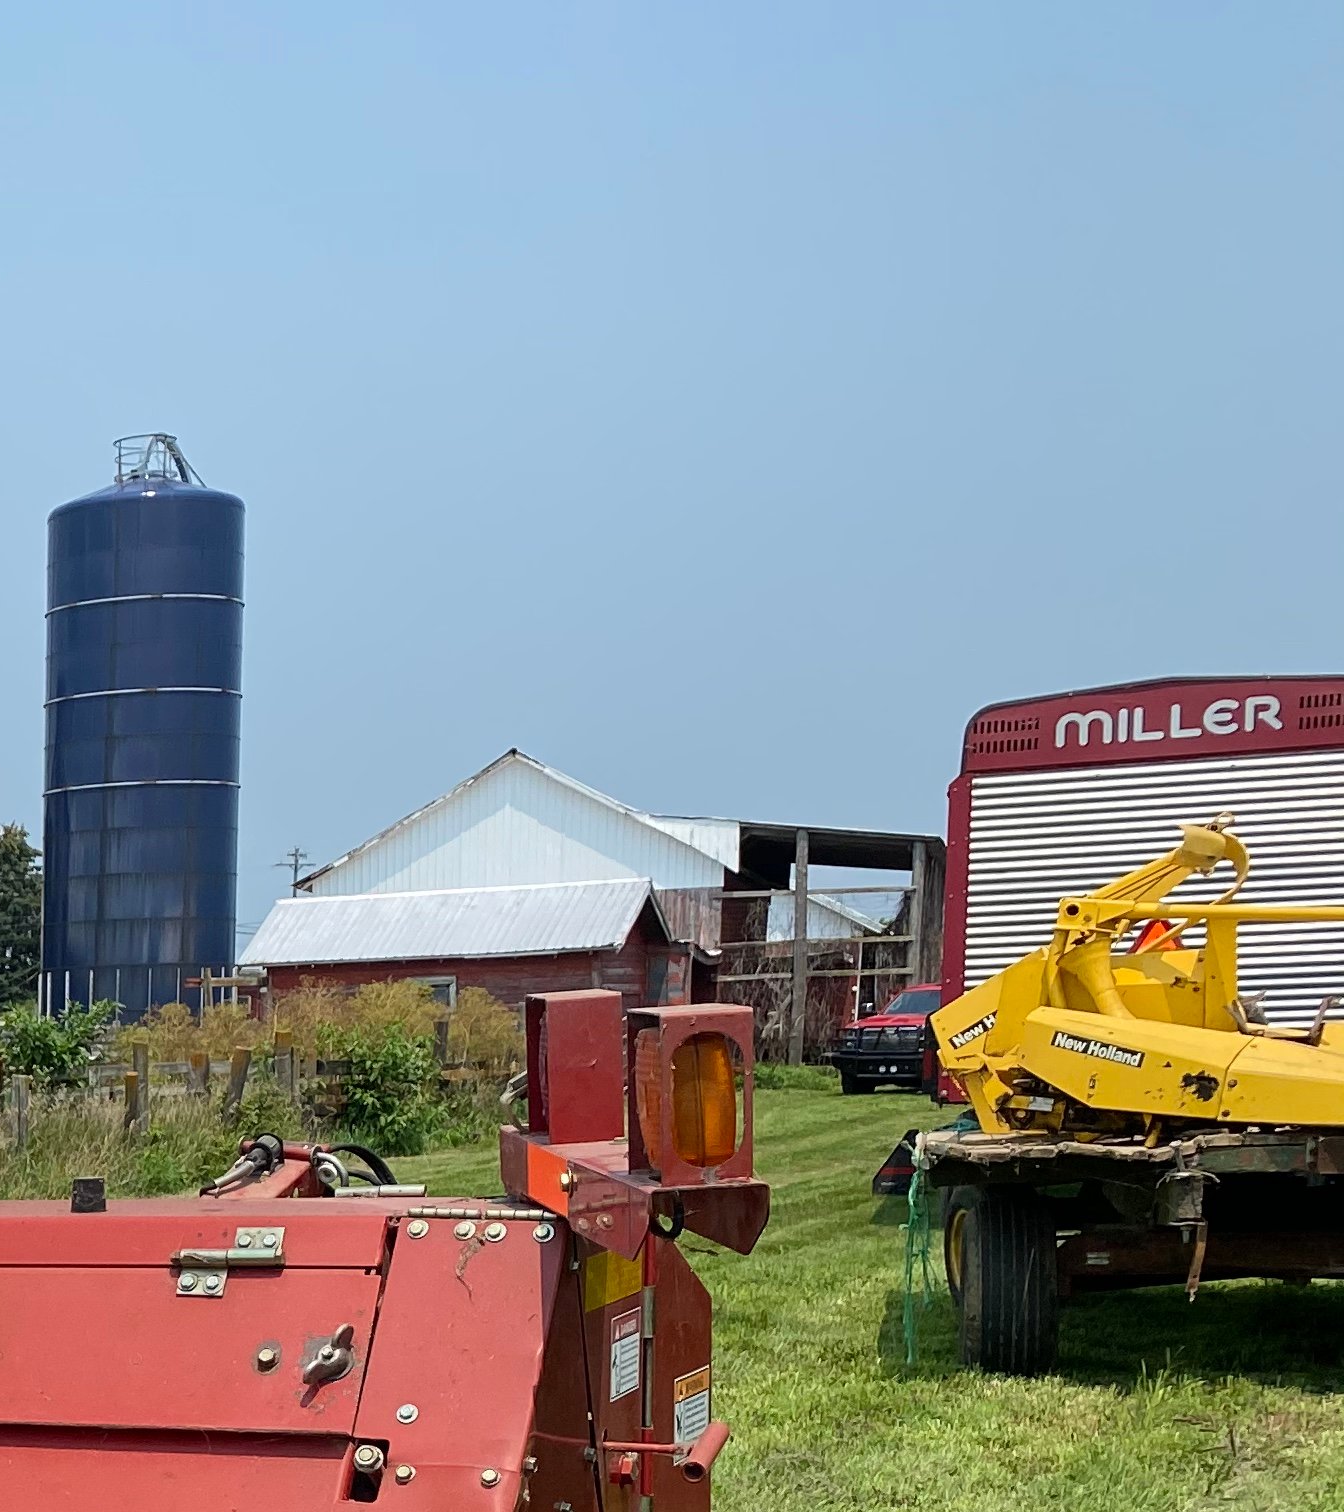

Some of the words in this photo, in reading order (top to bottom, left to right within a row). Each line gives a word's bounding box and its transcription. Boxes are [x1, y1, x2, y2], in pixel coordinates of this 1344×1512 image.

[1055, 695, 1283, 748] MILLER
[952, 1023, 985, 1048] New
[1054, 1032, 1086, 1054] New
[1087, 1040, 1141, 1067] Holland
